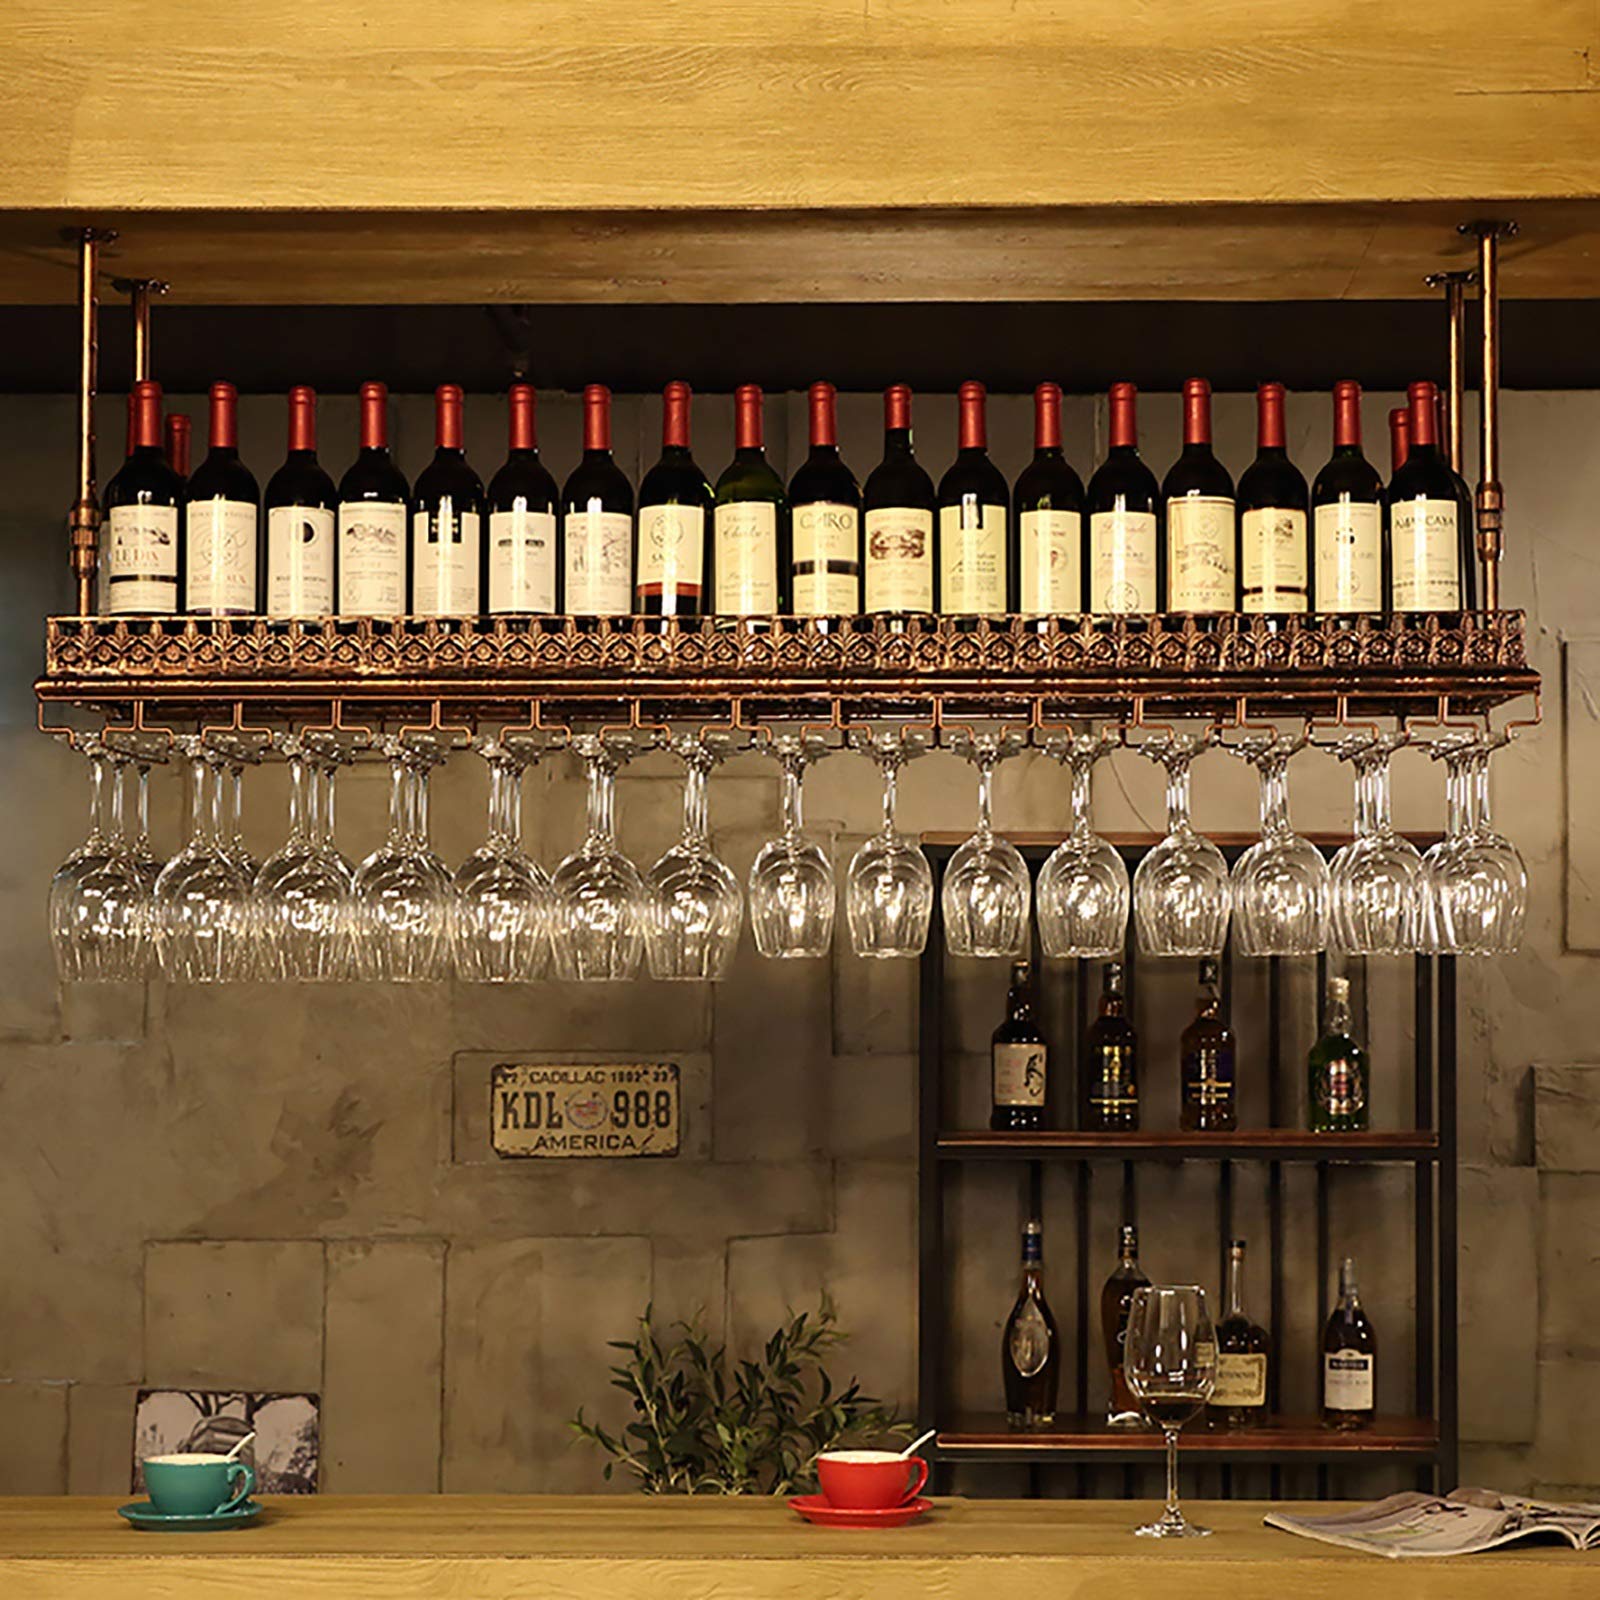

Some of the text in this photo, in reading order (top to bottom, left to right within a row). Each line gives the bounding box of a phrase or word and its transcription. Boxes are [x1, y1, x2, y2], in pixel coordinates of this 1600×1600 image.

[530, 1071, 605, 1084] CADILLAC
[501, 1090, 671, 1129] KDL 988
[534, 1135, 636, 1149] AMERICA
